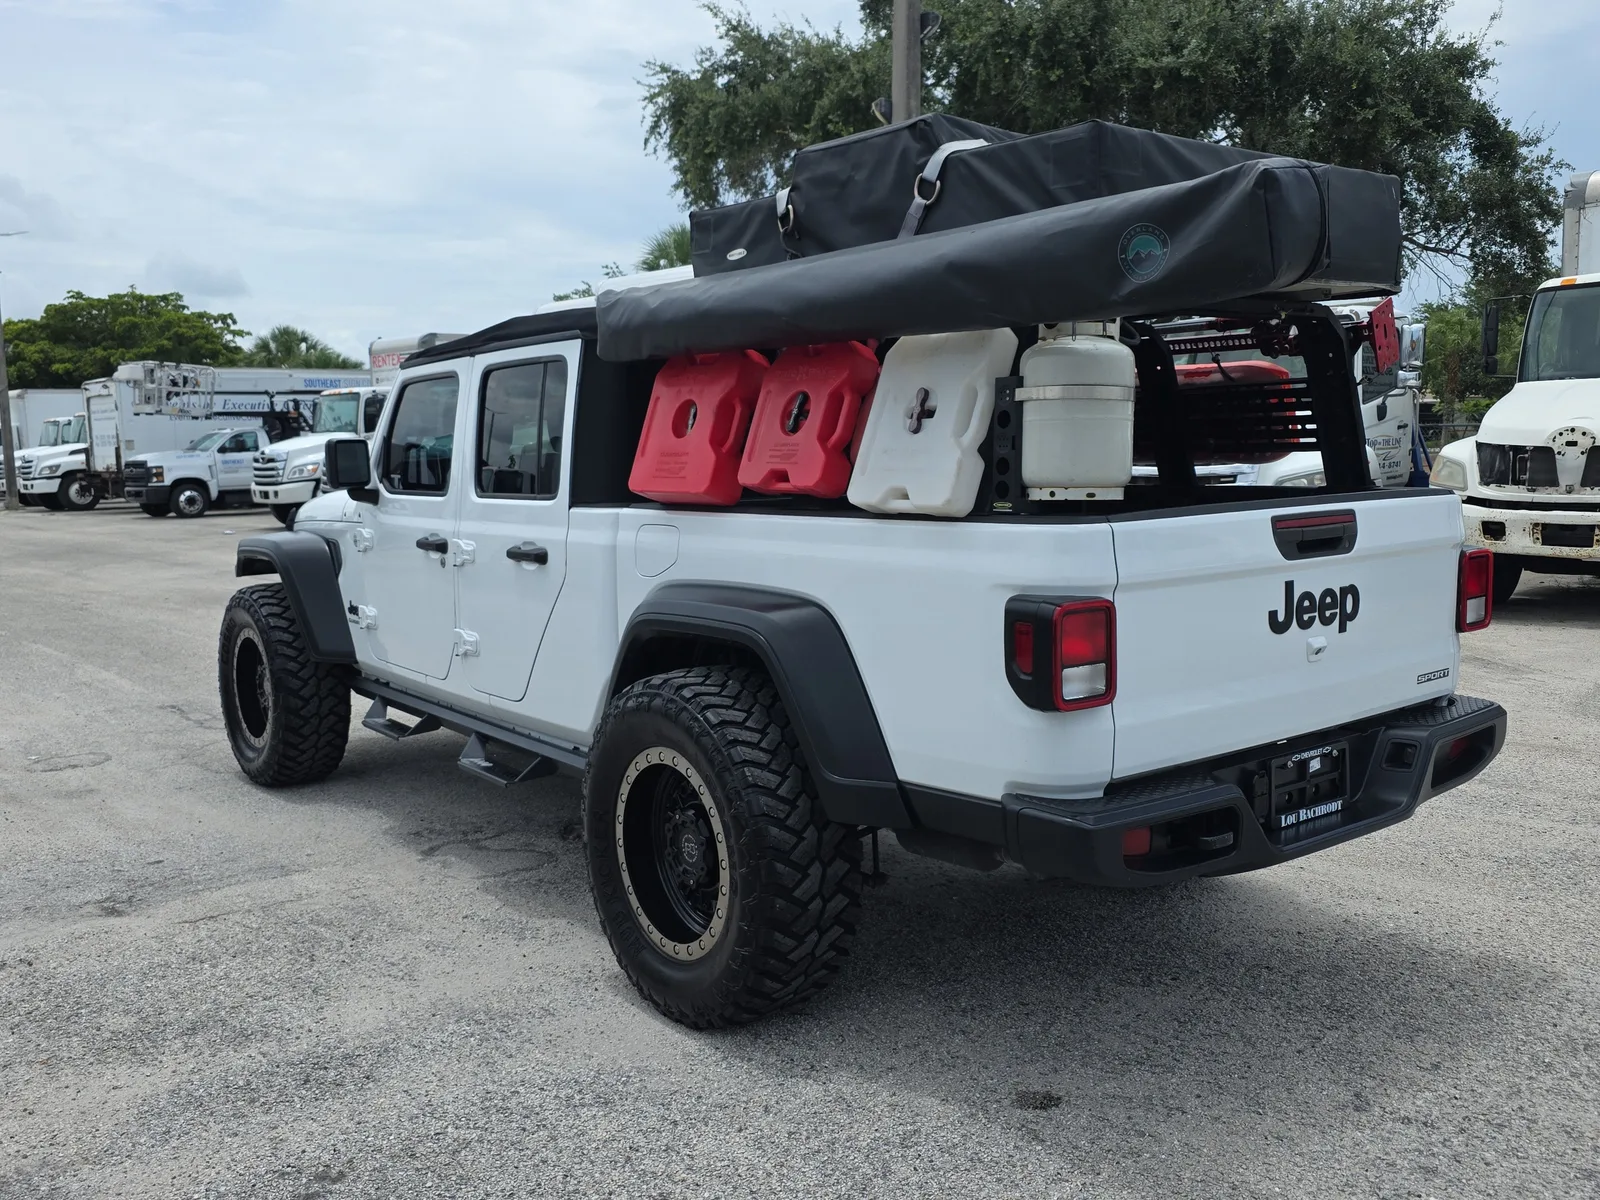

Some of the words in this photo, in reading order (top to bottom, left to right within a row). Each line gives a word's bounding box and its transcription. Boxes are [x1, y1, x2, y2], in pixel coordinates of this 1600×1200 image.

[303, 378, 342, 389] SOUTHEAST
[1268, 580, 1360, 635] Jeep
[1417, 669, 1450, 684] SPORT
[1300, 748, 1323, 760] CHEVROLET
[1281, 813, 1298, 828] LOU
[1299, 800, 1343, 822] BACHRODT
